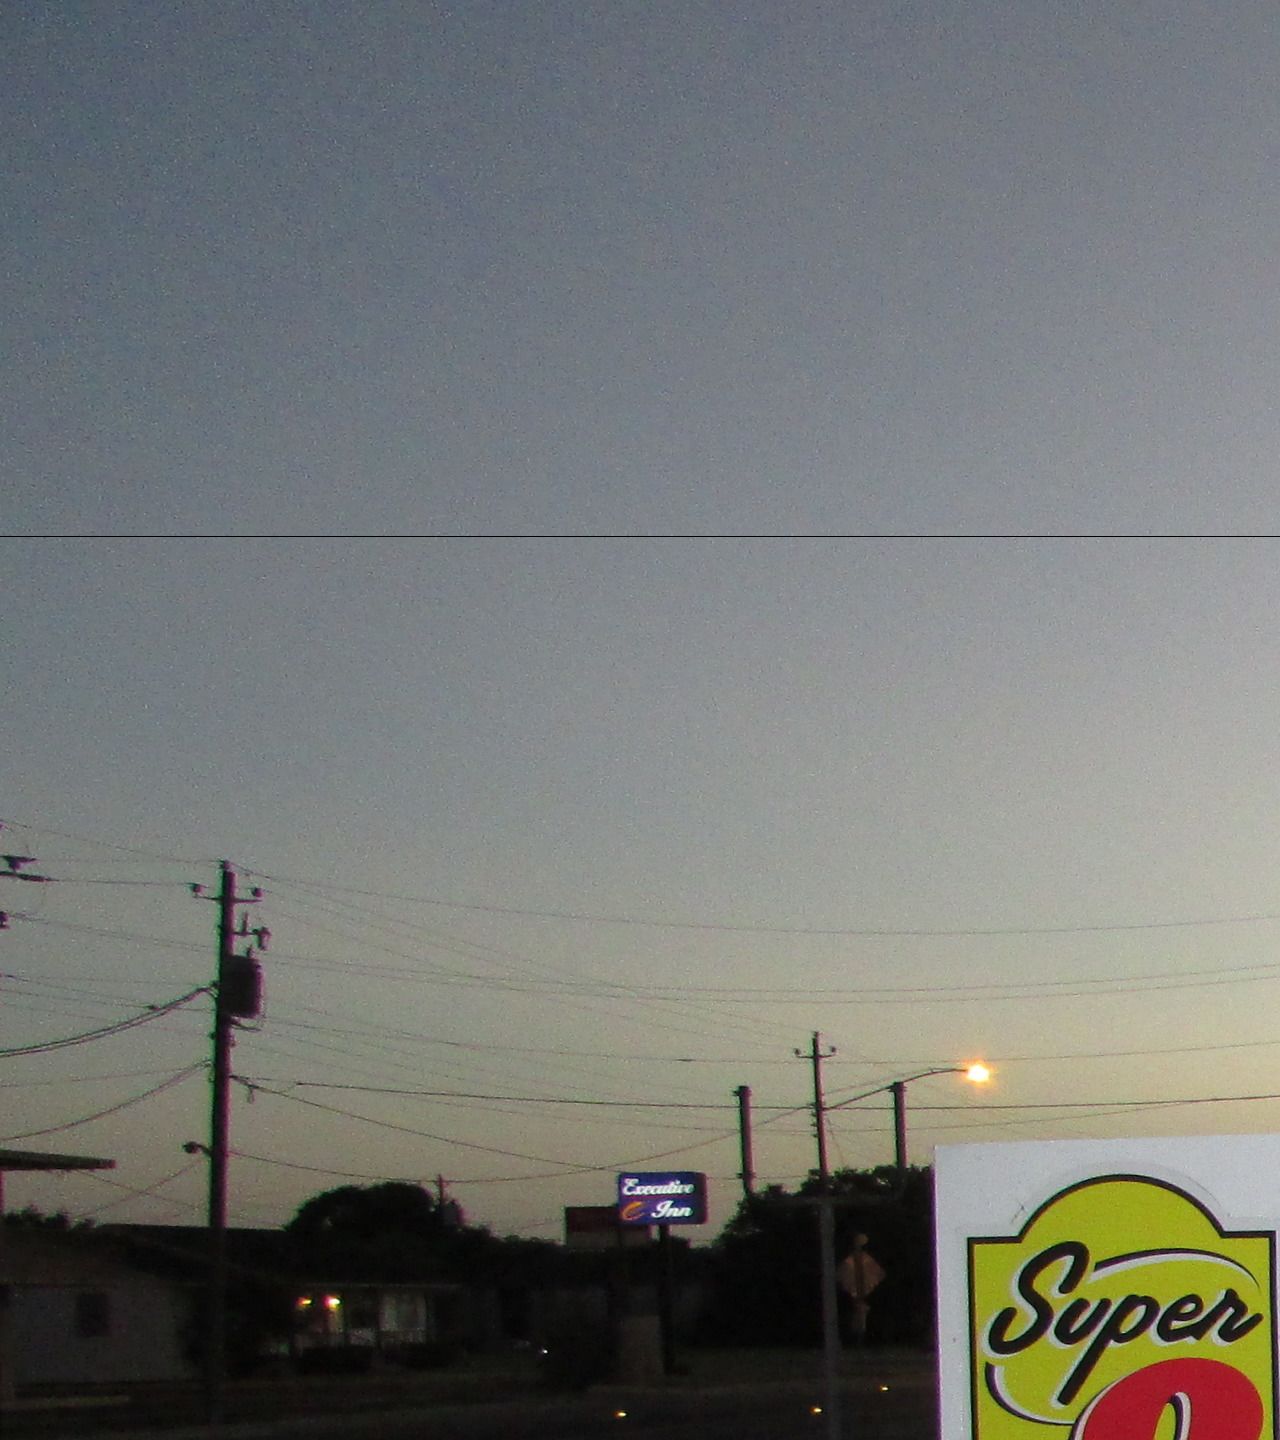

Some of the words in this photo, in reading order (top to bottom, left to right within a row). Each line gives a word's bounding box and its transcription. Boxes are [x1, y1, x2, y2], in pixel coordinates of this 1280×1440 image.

[622, 1178, 695, 1195] Executive
[651, 1200, 693, 1218] Inn
[987, 1240, 1263, 1406] Super
